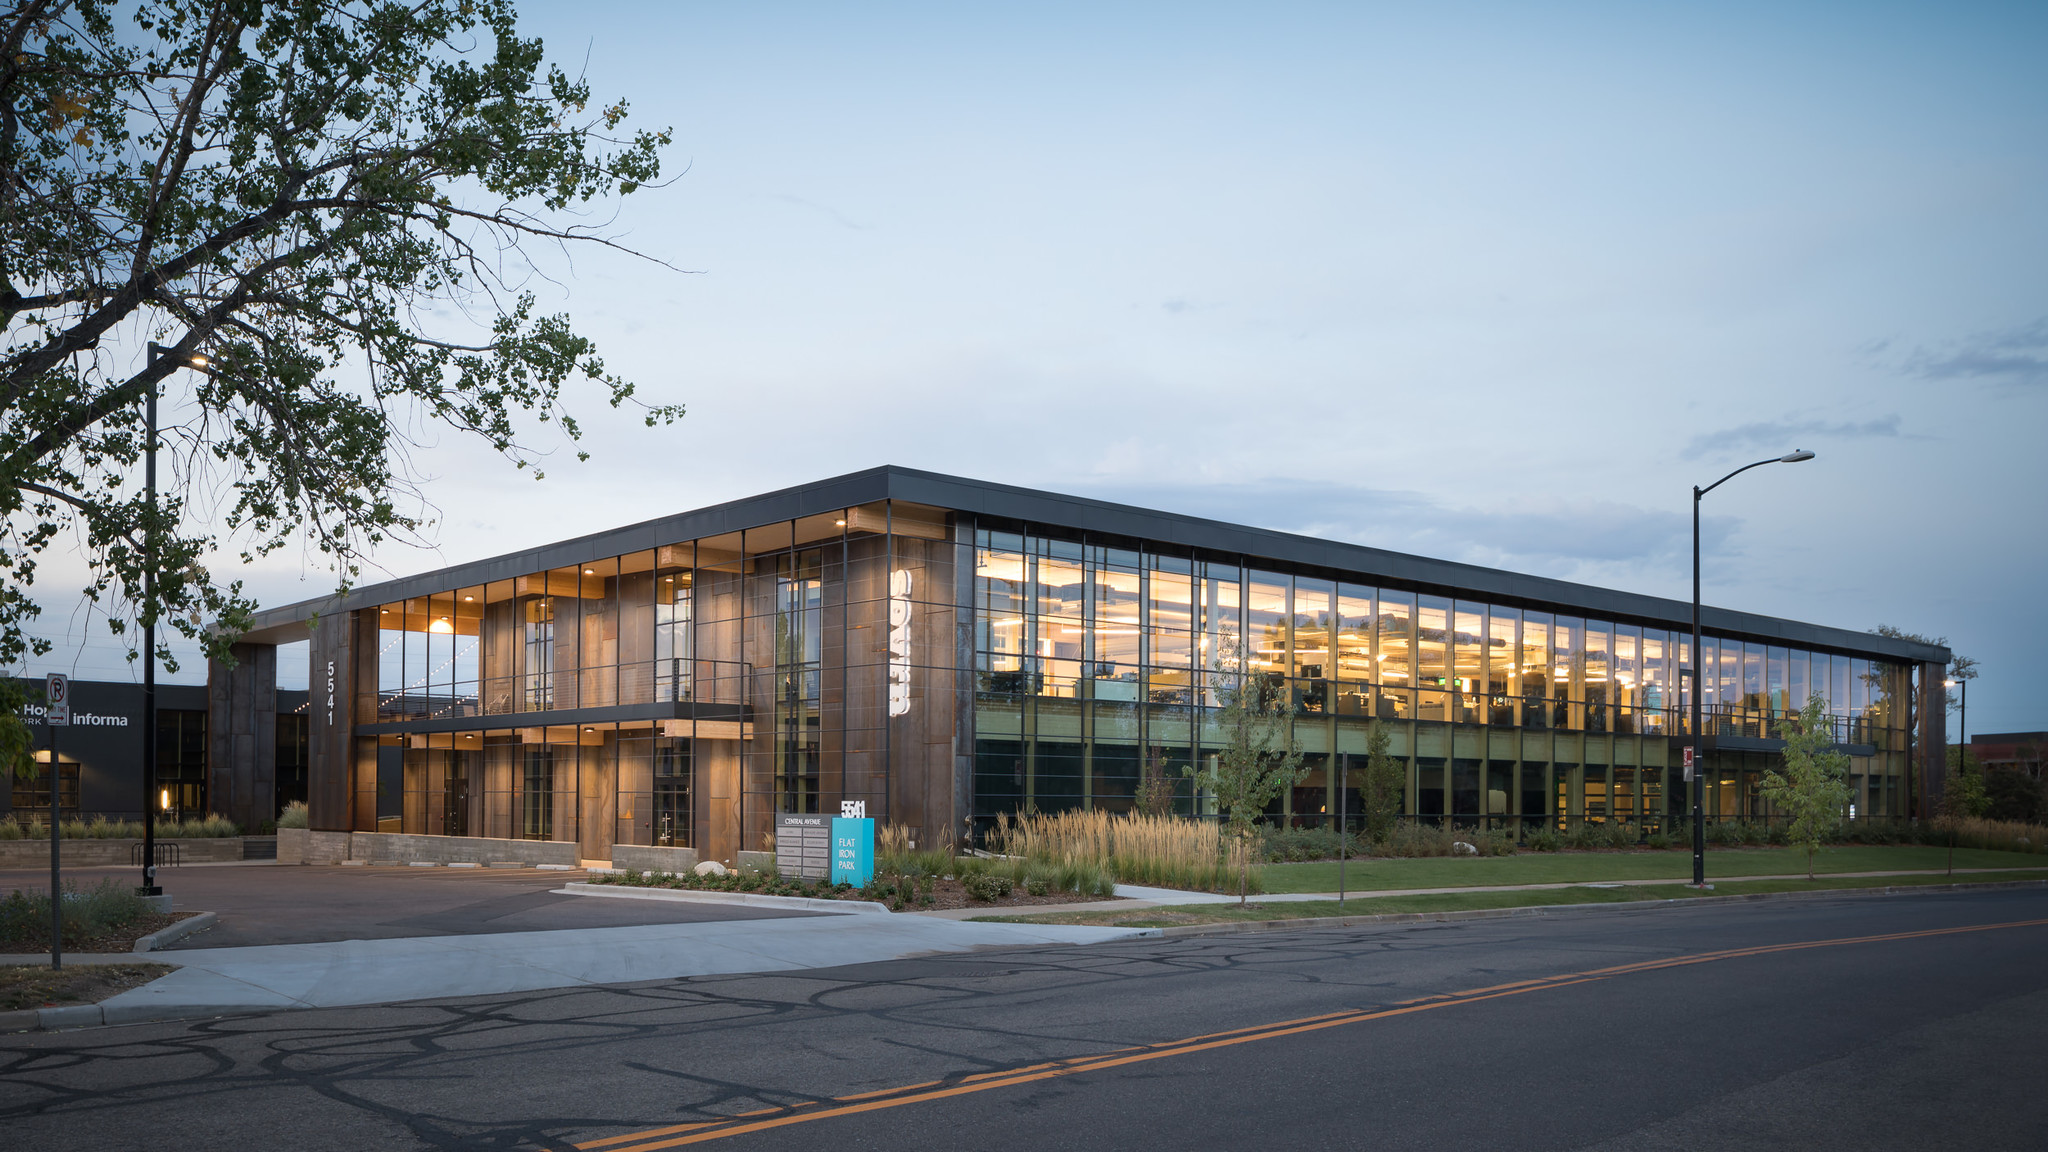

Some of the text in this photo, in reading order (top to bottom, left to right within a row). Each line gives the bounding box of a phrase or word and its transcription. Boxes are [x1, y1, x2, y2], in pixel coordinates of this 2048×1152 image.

[73, 712, 128, 726] informa
[842, 800, 865, 818] 5541
[839, 838, 855, 847] FLAT
[839, 849, 855, 858] IRON
[839, 861, 855, 870] PARK
